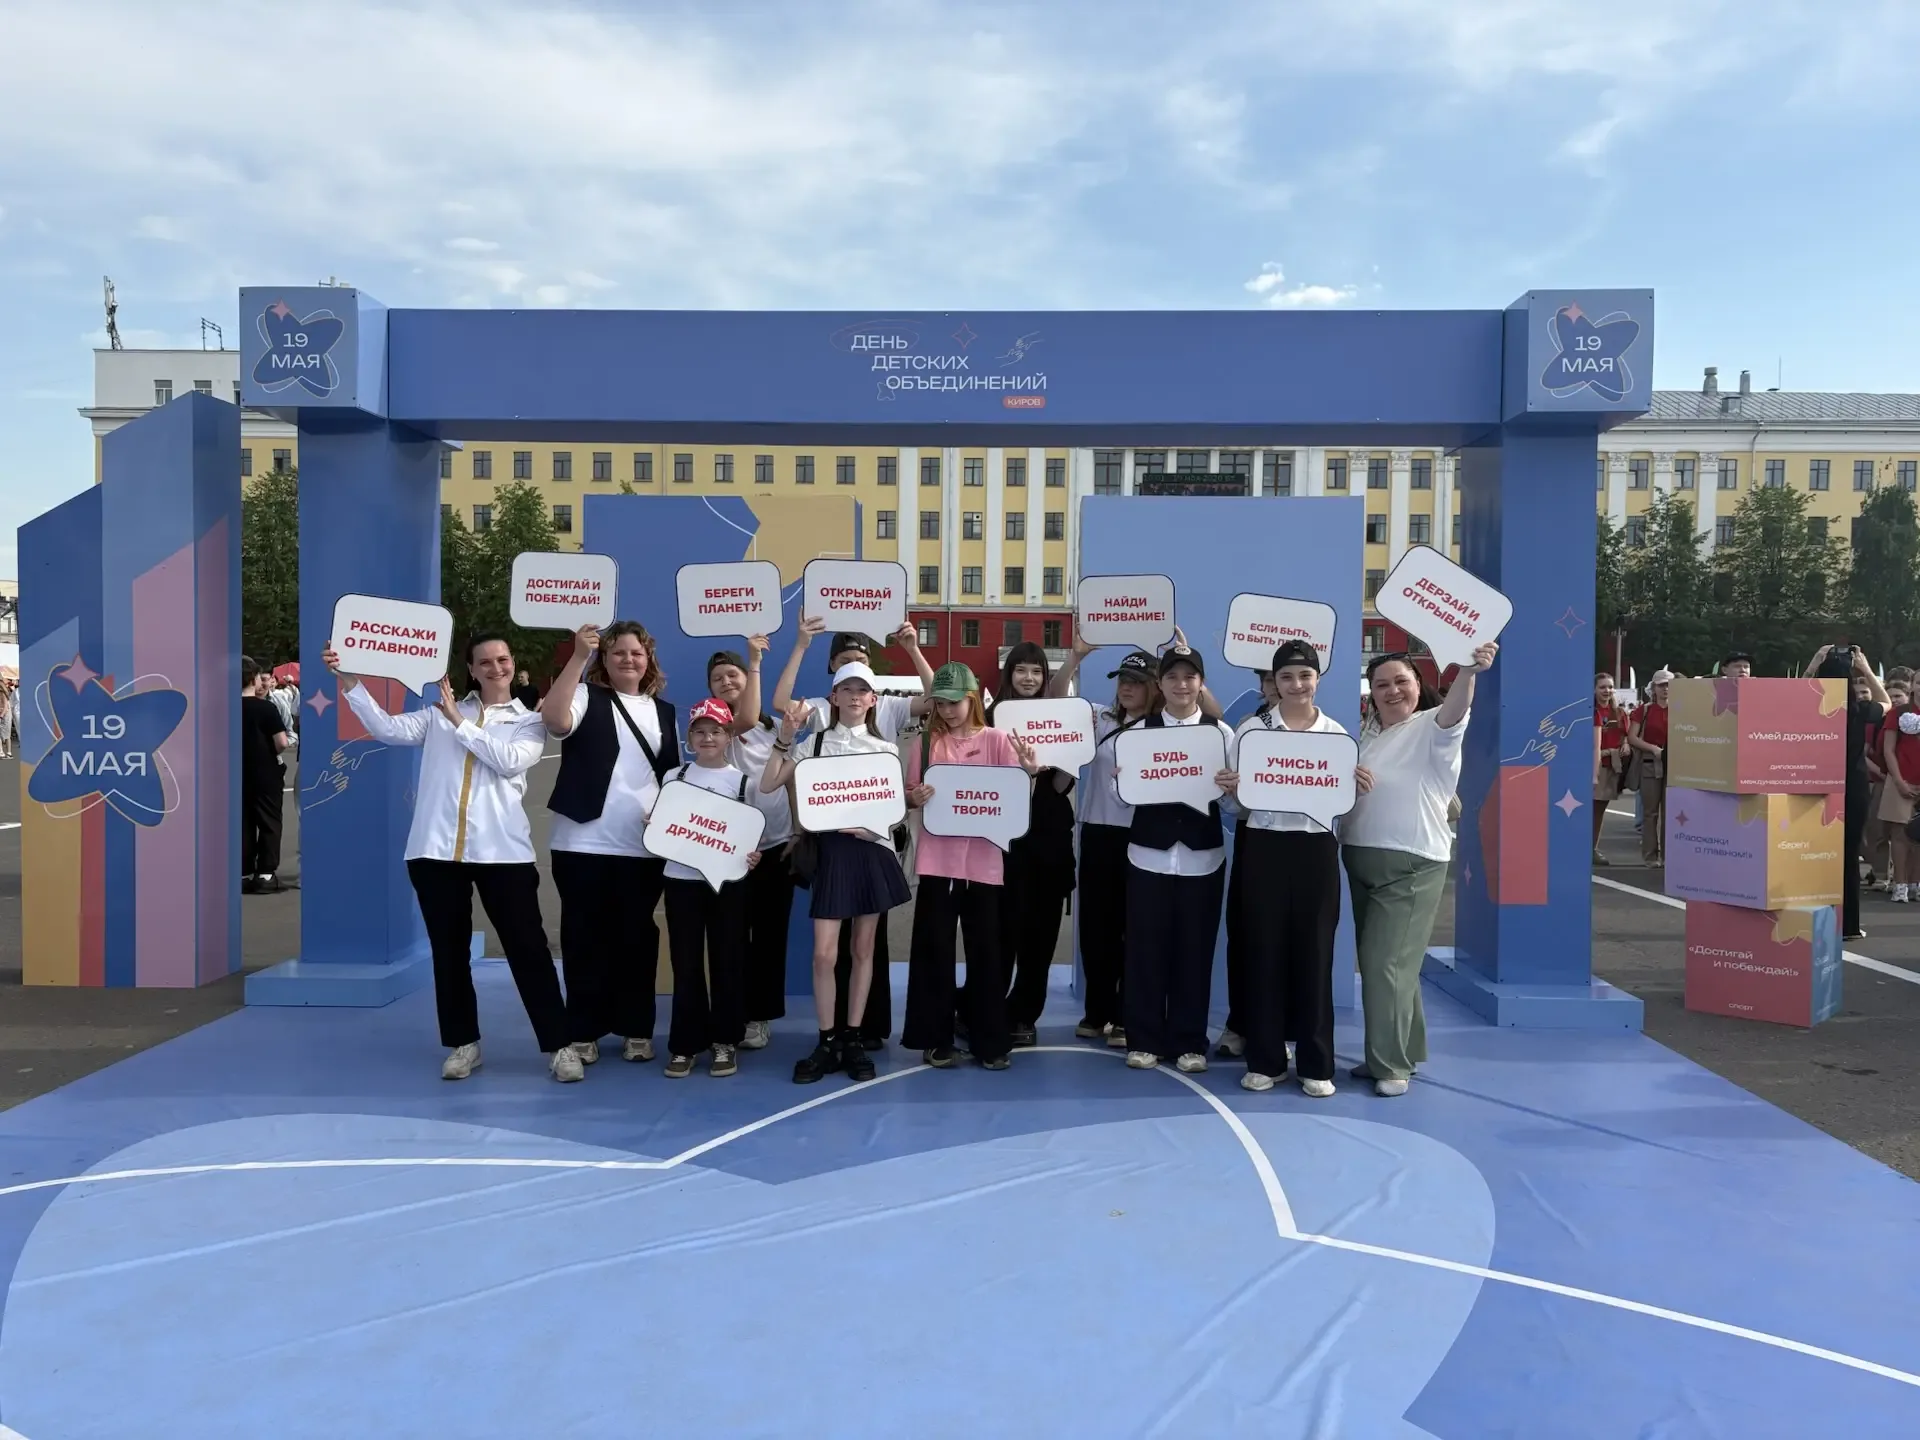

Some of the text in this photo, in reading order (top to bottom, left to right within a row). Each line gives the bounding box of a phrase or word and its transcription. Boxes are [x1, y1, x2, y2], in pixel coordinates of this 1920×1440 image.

[283, 333, 309, 347] 19
[851, 335, 908, 351] ДЕНЬ
[1574, 336, 1602, 351] 19
[272, 354, 320, 369] МАЯ
[871, 355, 969, 371] ДЕТСКИХ
[1562, 358, 1613, 372] МАЯ
[886, 372, 1047, 392] ОБЪЕДИНЕНИЙ
[1007, 398, 1041, 406] КИРОВ
[526, 578, 601, 591] ДОСТИГАЙ И
[525, 593, 601, 606] ПОБЕЖДАЙ!
[704, 587, 755, 599] БЕРЕГИ
[820, 587, 892, 599] ОТКРЫВАЙ
[1415, 577, 1480, 622] ДЕРЗАЙ И
[698, 602, 762, 614] ПЛАНЕТУ!
[829, 600, 882, 611] СТРАНУ!
[1104, 596, 1147, 608] НАЙДИ
[1087, 612, 1165, 623] ПРИЗВАНИЕ!
[1402, 587, 1476, 638] ОТКРЫВАЙ!
[350, 620, 437, 641] РАССКАЖИ
[1250, 623, 1312, 639] ЕСЛИ БЫТЬ,
[1232, 632, 1246, 642] ТО
[1246, 634, 1275, 646] БЫТЬ
[344, 637, 438, 659] О ГЛАВНОМ!
[81, 714, 126, 740] 19
[1027, 720, 1062, 730] БЫТЬ
[1748, 731, 1839, 744] «Умей дружить!»
[62, 751, 146, 776] МАЯ
[1153, 751, 1188, 763] БУДЬ
[1267, 756, 1328, 770] УЧИСЬ И
[1140, 766, 1203, 780] ЗДОРОВ!
[812, 777, 889, 793] СОЗДАВАЙ И
[1254, 773, 1339, 788] ПОЗНАВАЙ!
[808, 789, 896, 807] ВДОХНОВЛЯЙ!
[955, 790, 999, 801] БЛАГО
[952, 805, 1001, 816] ТВОРИ!
[688, 812, 728, 834] УМЕЙ
[665, 823, 737, 855] ДРУЖИТЬ!
[1689, 945, 1753, 960] «Достигай
[1713, 960, 1799, 977] и побеждай!»
[1729, 1002, 1753, 1012] спорт
